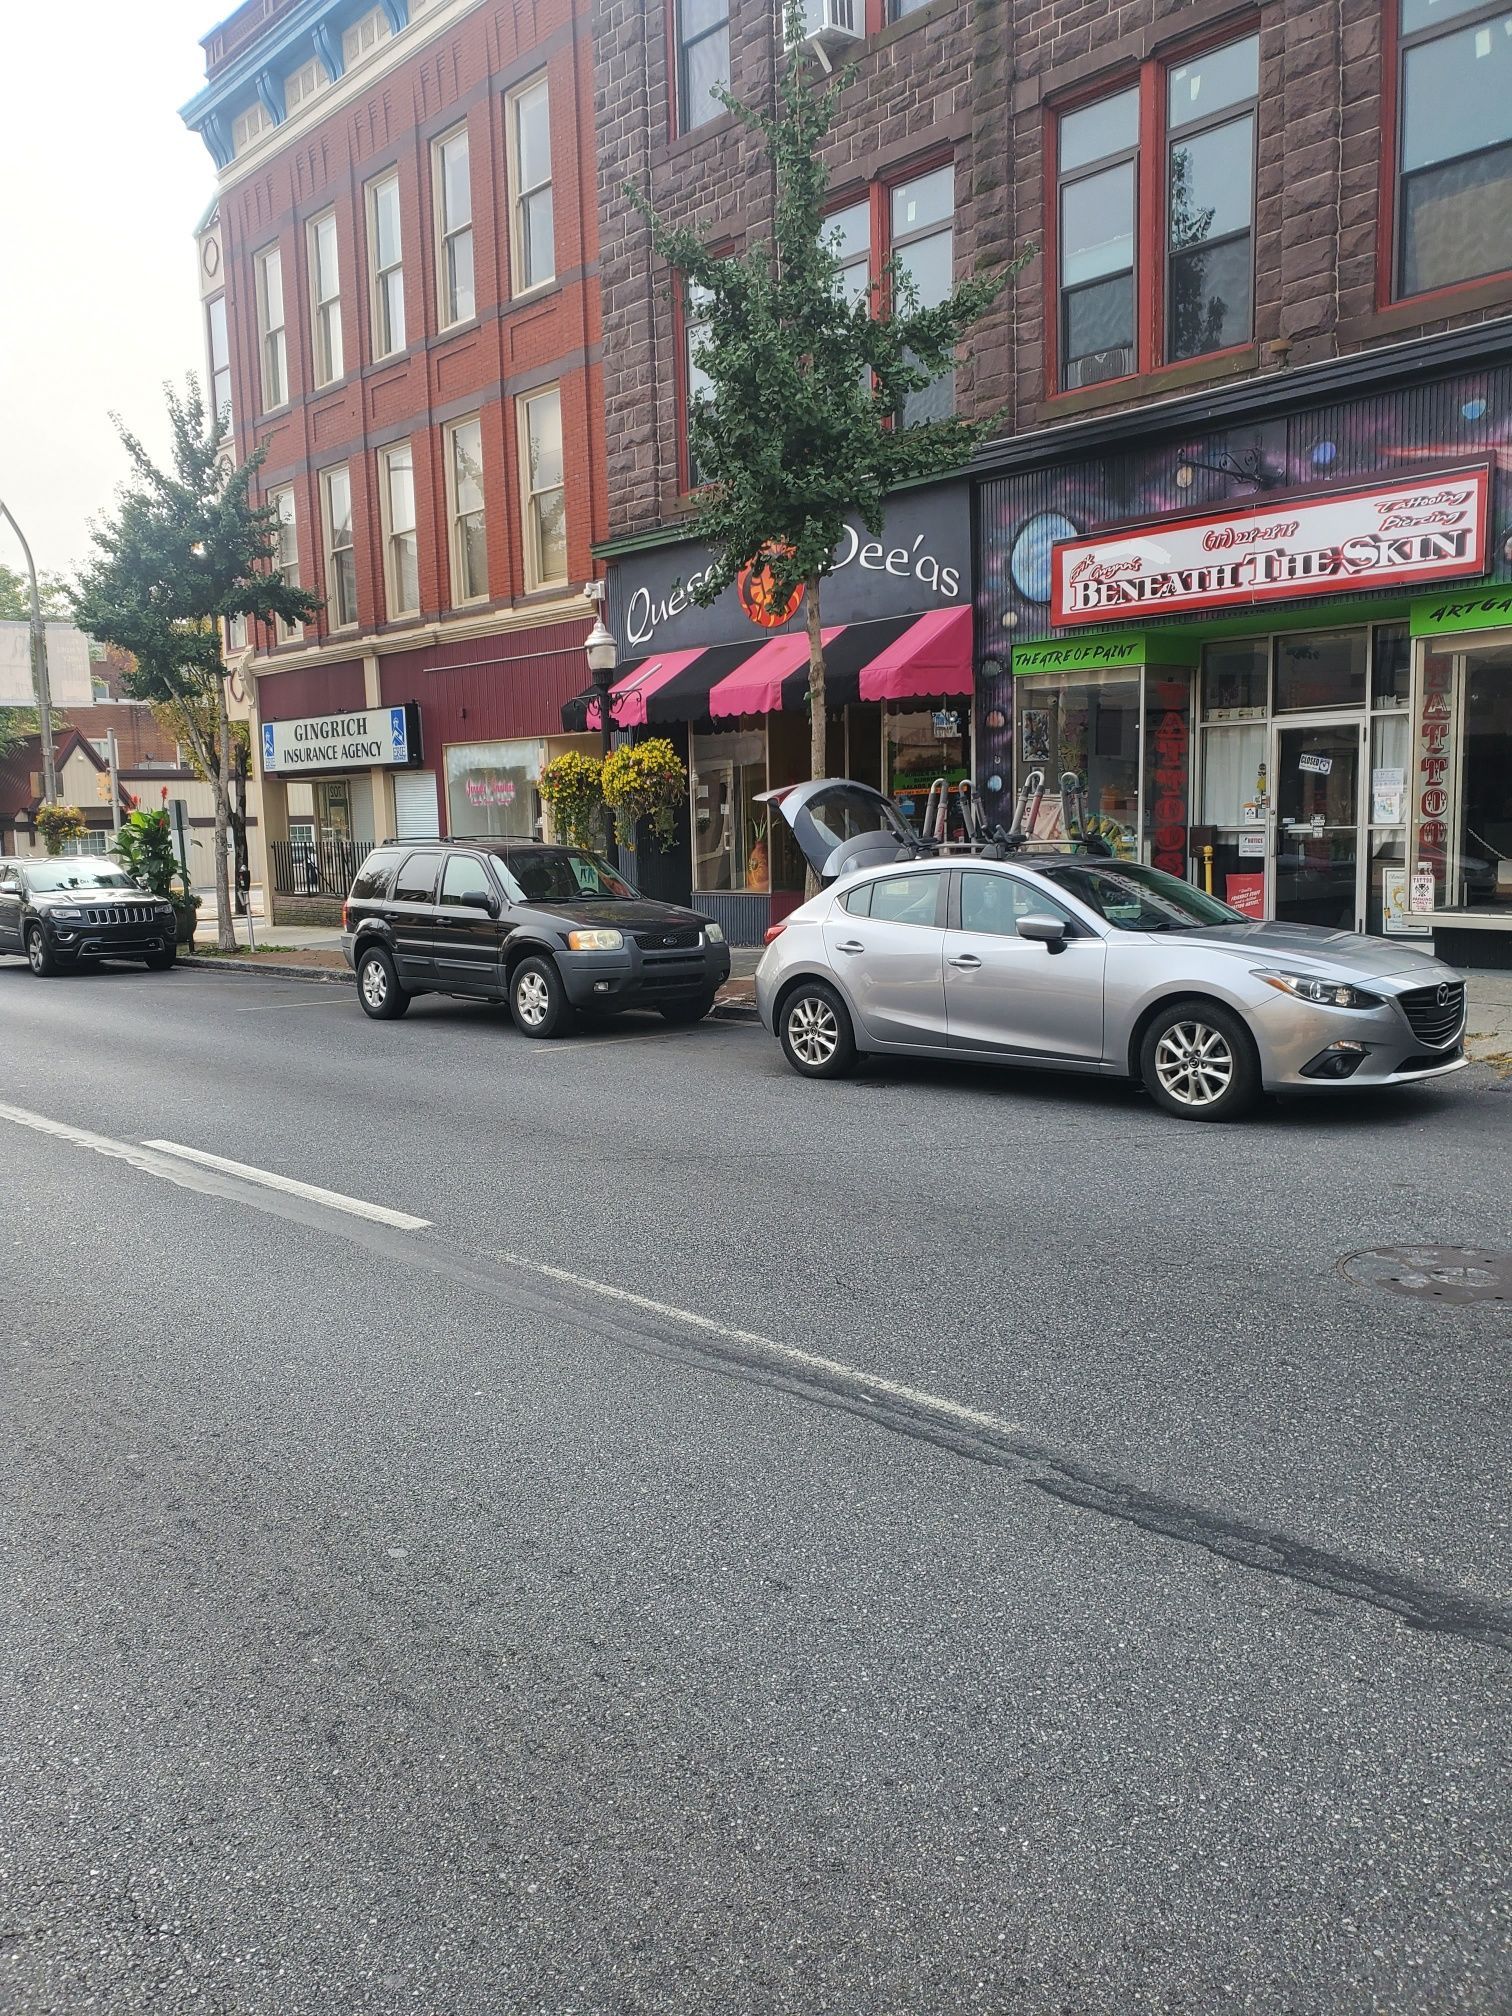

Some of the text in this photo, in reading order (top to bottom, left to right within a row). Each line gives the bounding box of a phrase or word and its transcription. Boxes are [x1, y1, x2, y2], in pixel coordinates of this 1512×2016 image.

[1376, 491, 1469, 513] Tattooing
[1379, 511, 1466, 531] Piercing
[1071, 530, 1467, 611] BENEATH THE SKIN
[1015, 643, 1139, 668] THEATRE OF PAINT
[294, 717, 368, 742] GINGRICH
[284, 741, 383, 763] INSURANCE AGENCY
[1300, 755, 1320, 767] CLOSED
